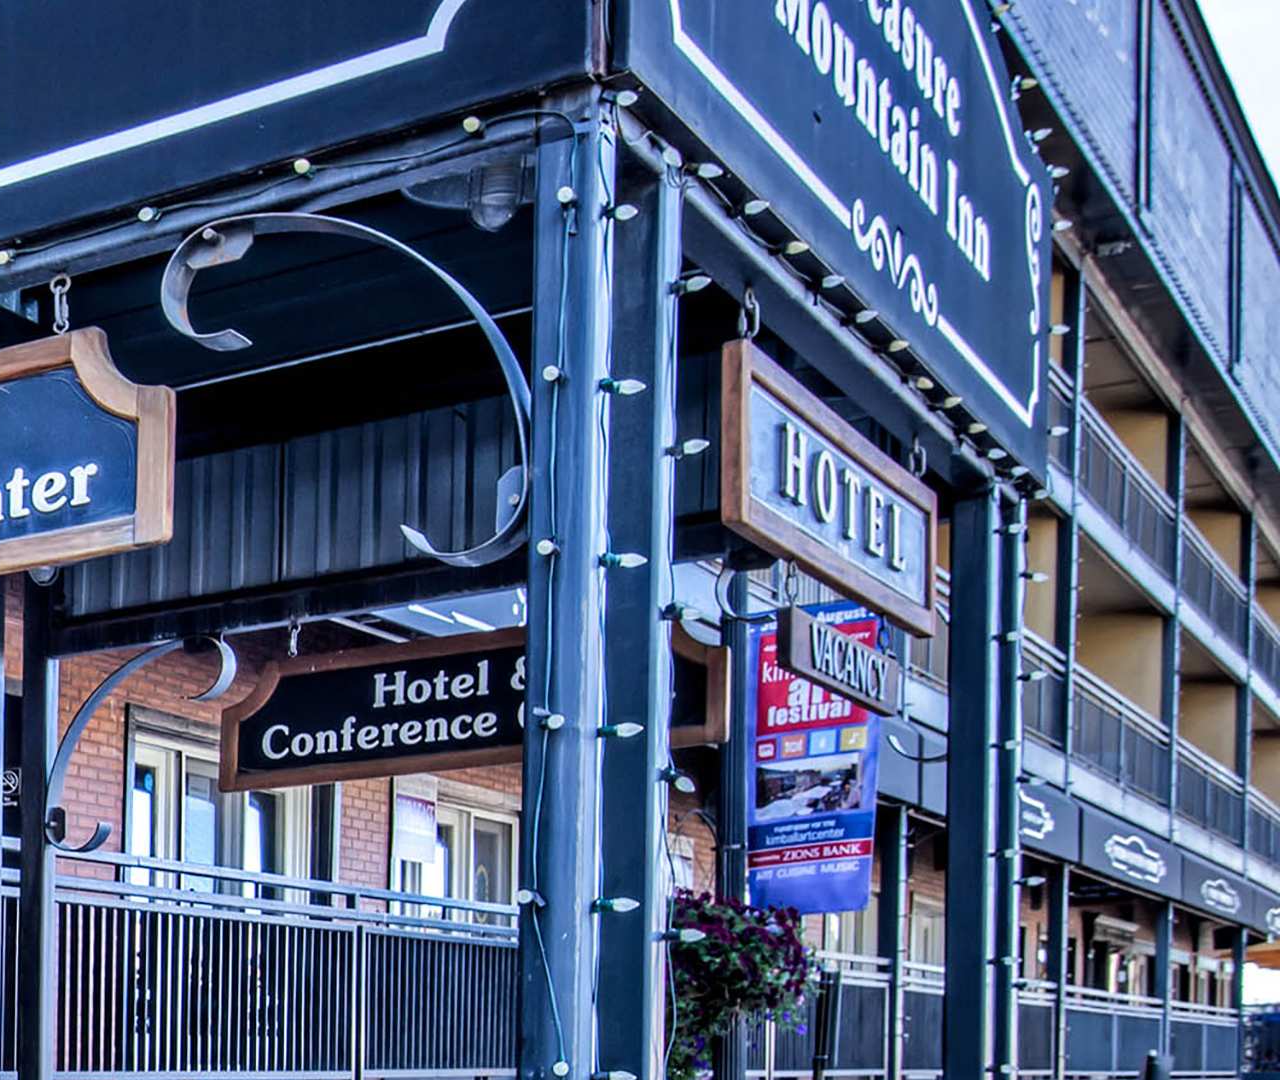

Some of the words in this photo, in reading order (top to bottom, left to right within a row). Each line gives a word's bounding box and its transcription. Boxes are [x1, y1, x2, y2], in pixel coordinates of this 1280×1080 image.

[868, 0, 960, 137] asure
[946, 159, 990, 282] Inn
[782, 421, 907, 572] HOTEL
[372, 660, 489, 708] Hotel
[809, 620, 890, 701] VACANCY
[767, 699, 851, 727] festival
[788, 678, 844, 707] ar
[262, 712, 497, 760] Conference
[782, 847, 821, 862] ZIONS
[823, 843, 862, 857] BANK
